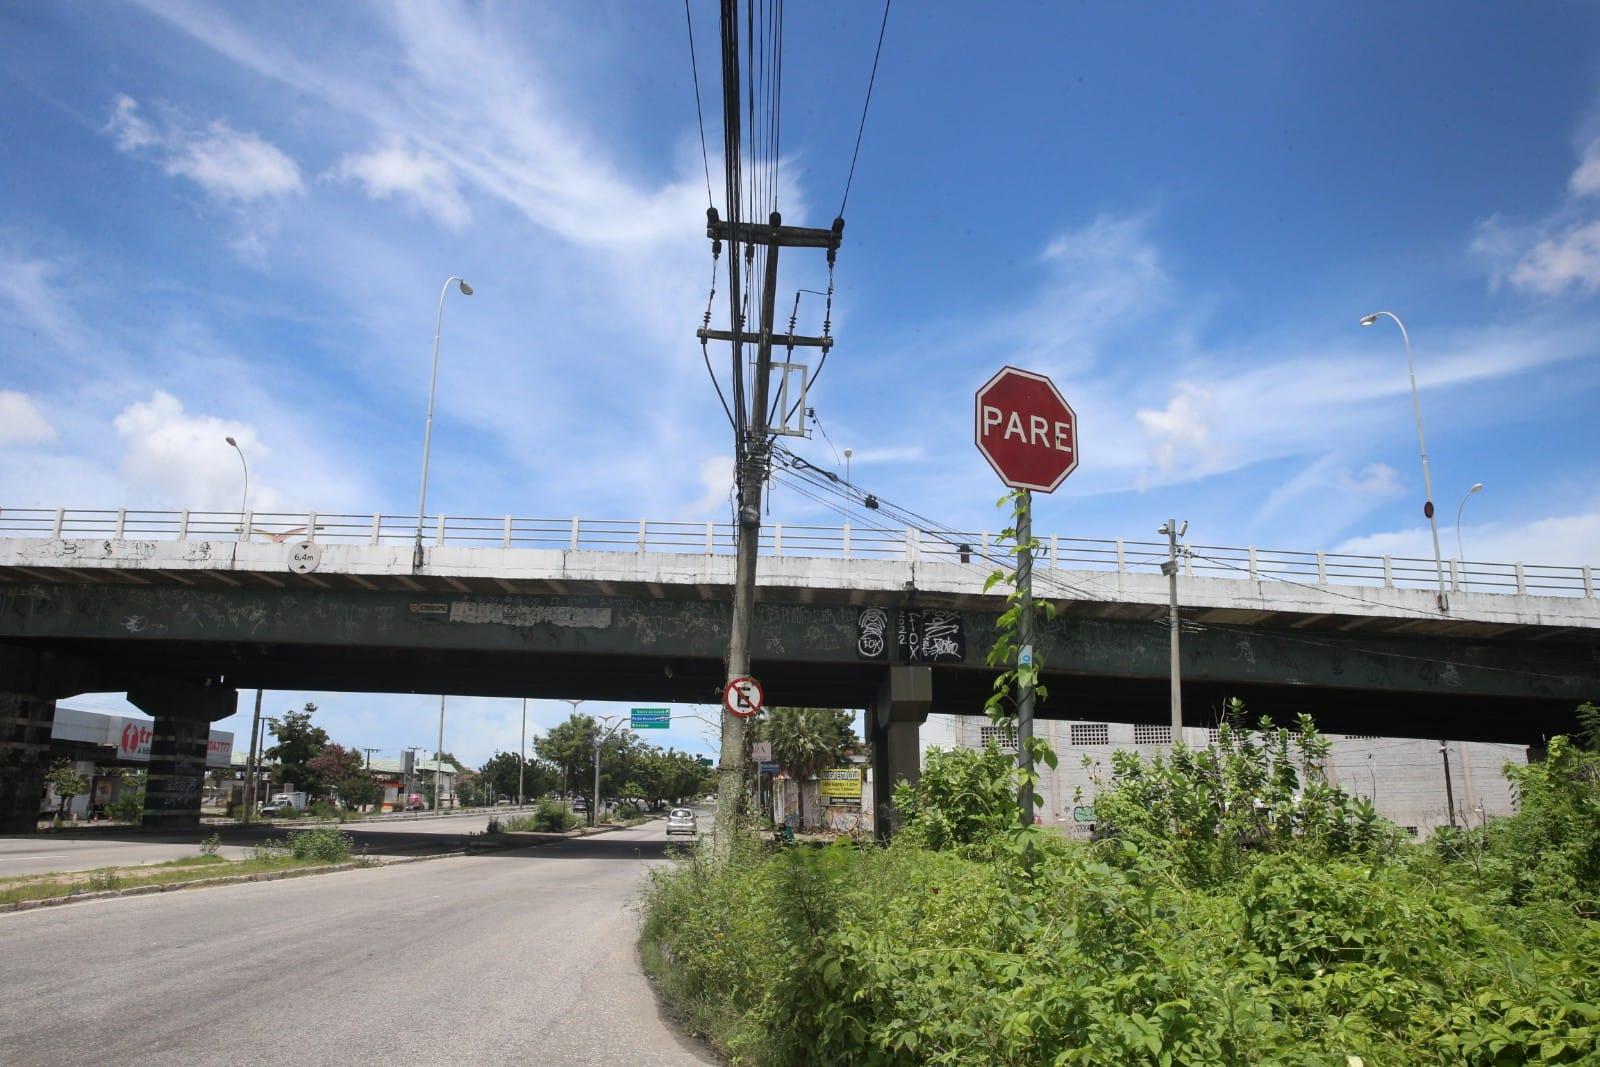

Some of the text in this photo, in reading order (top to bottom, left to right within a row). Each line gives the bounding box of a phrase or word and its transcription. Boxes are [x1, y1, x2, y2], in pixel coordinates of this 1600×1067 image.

[983, 405, 1072, 452] PARE
[294, 553, 314, 561] 6,4m
[736, 686, 751, 708] E
